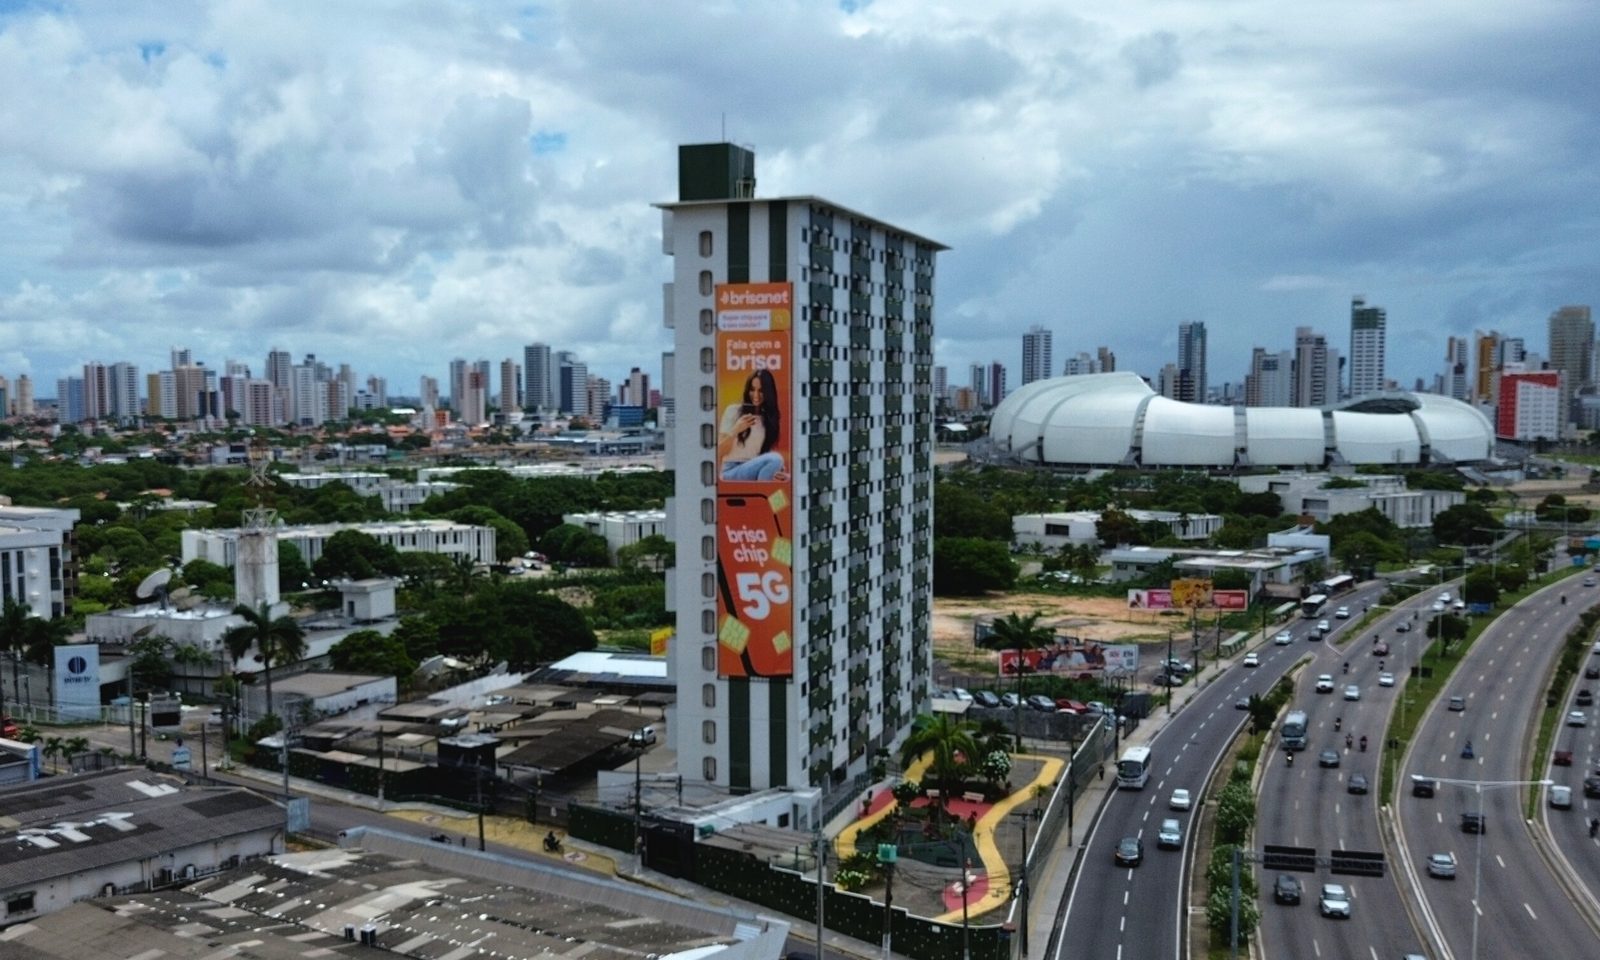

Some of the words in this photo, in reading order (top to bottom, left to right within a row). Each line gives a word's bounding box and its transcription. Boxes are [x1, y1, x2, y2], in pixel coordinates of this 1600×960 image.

[730, 290, 788, 304] brisanet
[727, 339, 747, 349] Fala
[749, 341, 772, 349] com
[774, 341, 781, 349] a
[726, 349, 781, 370] brisa
[725, 525, 767, 544] brisa
[733, 543, 768, 567] chip
[736, 570, 789, 620] 5G
